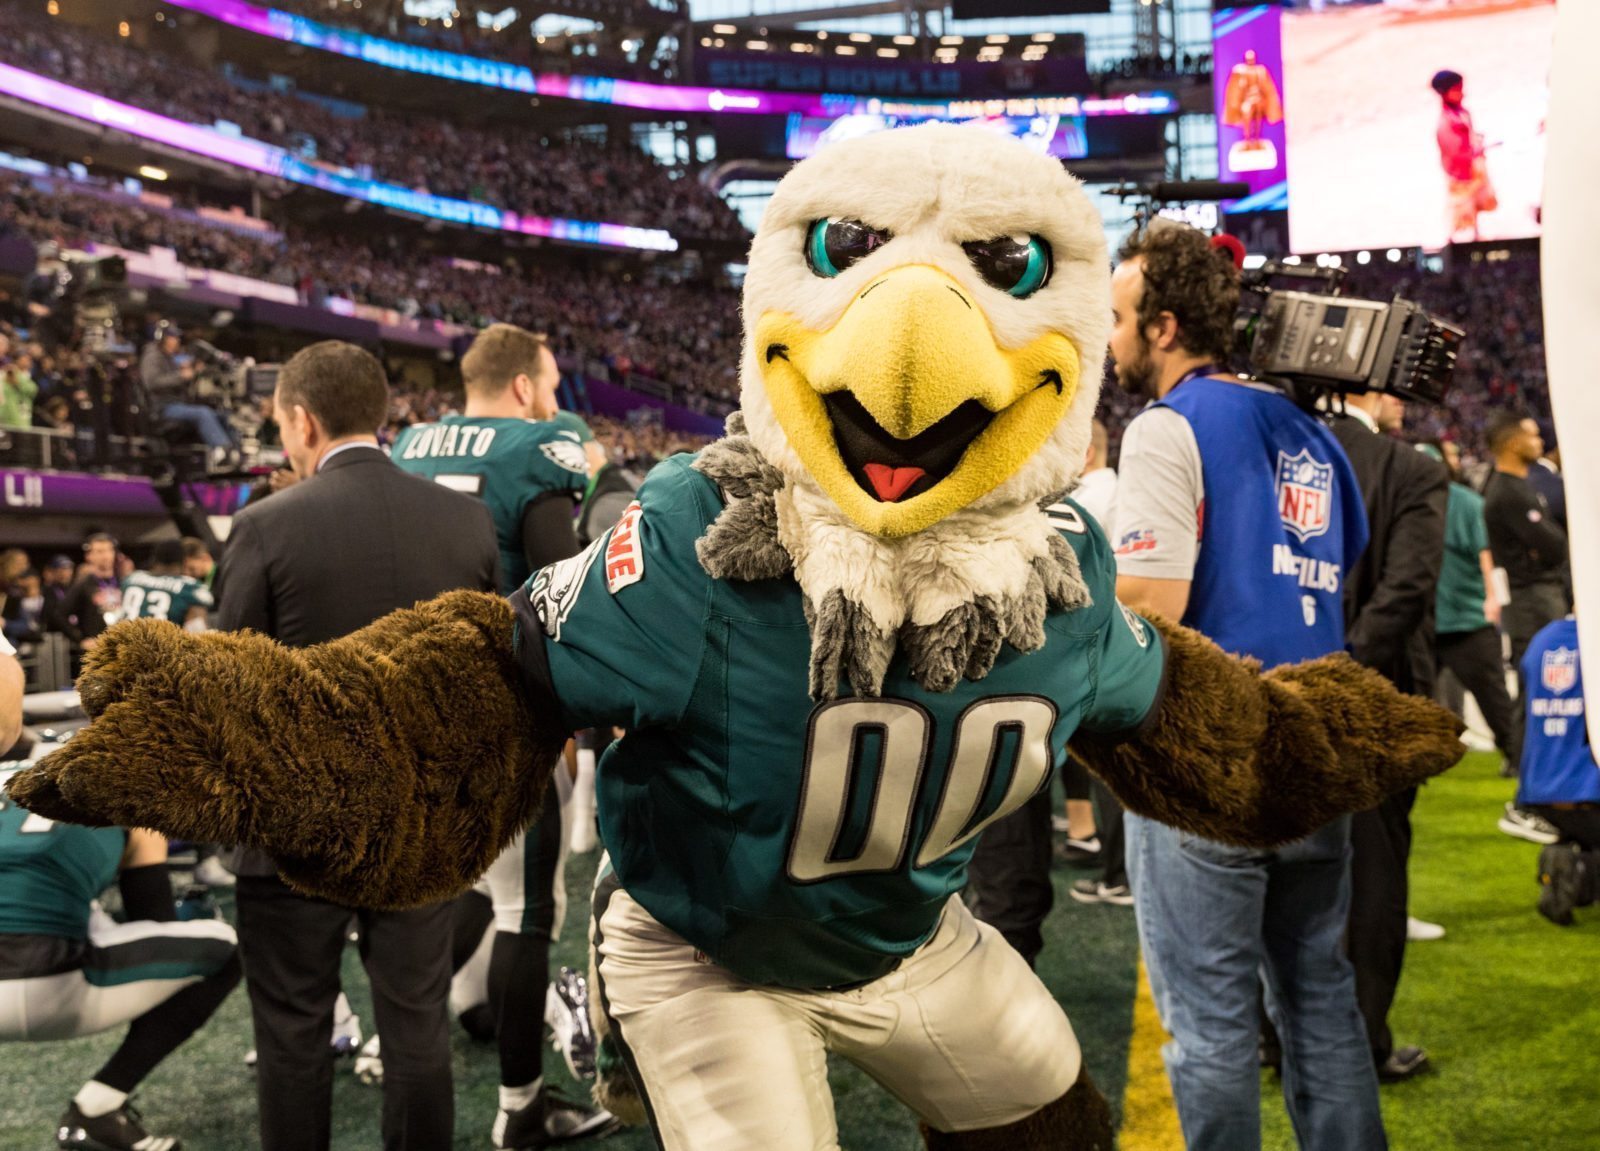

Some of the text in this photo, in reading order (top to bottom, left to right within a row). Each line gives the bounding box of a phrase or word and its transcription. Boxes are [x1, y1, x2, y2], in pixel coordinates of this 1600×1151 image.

[361, 35, 537, 93] MINNESOTA
[708, 60, 821, 88] SUPER
[826, 66, 917, 91] BOWL
[402, 424, 496, 459] LOVATO
[1281, 485, 1323, 527] NFL
[122, 586, 172, 622] 93
[787, 694, 1059, 884] 00
